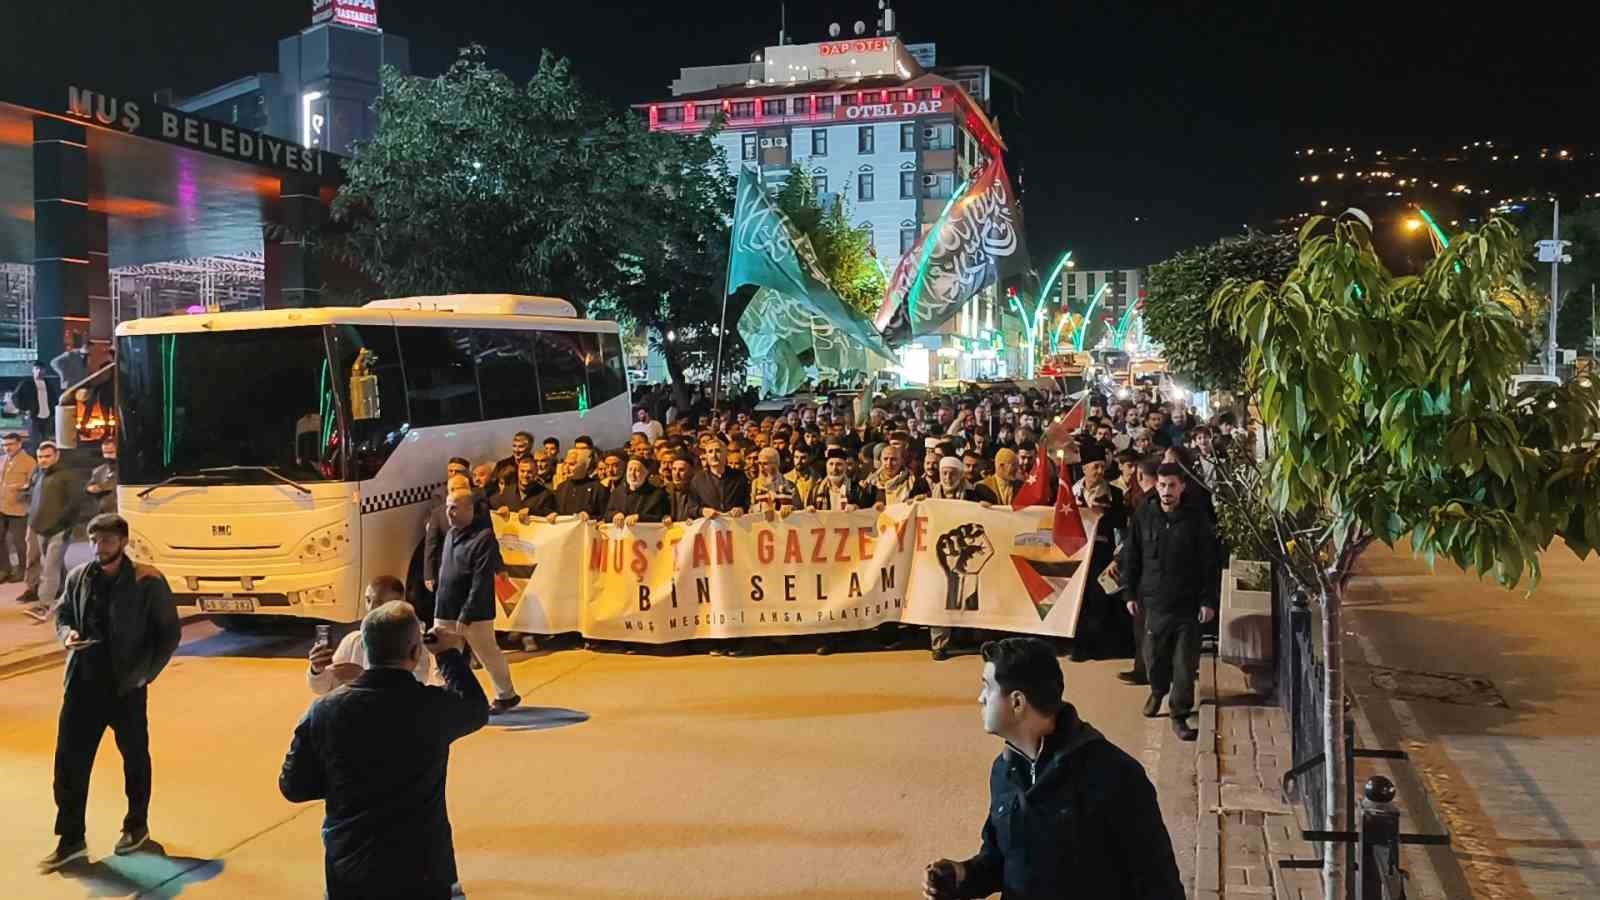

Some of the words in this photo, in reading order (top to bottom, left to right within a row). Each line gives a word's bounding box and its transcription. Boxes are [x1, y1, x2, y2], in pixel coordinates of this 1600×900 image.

[820, 43, 849, 56] DAP
[854, 39, 889, 53] OTEL
[846, 103, 897, 119] OTEL
[903, 100, 943, 115] DAP
[66, 85, 142, 134] MUŞ
[162, 110, 323, 175] BELEDİYESİ
[211, 524, 232, 537] BMC
[638, 575, 711, 612] BİN
[750, 565, 895, 602] SELAM
